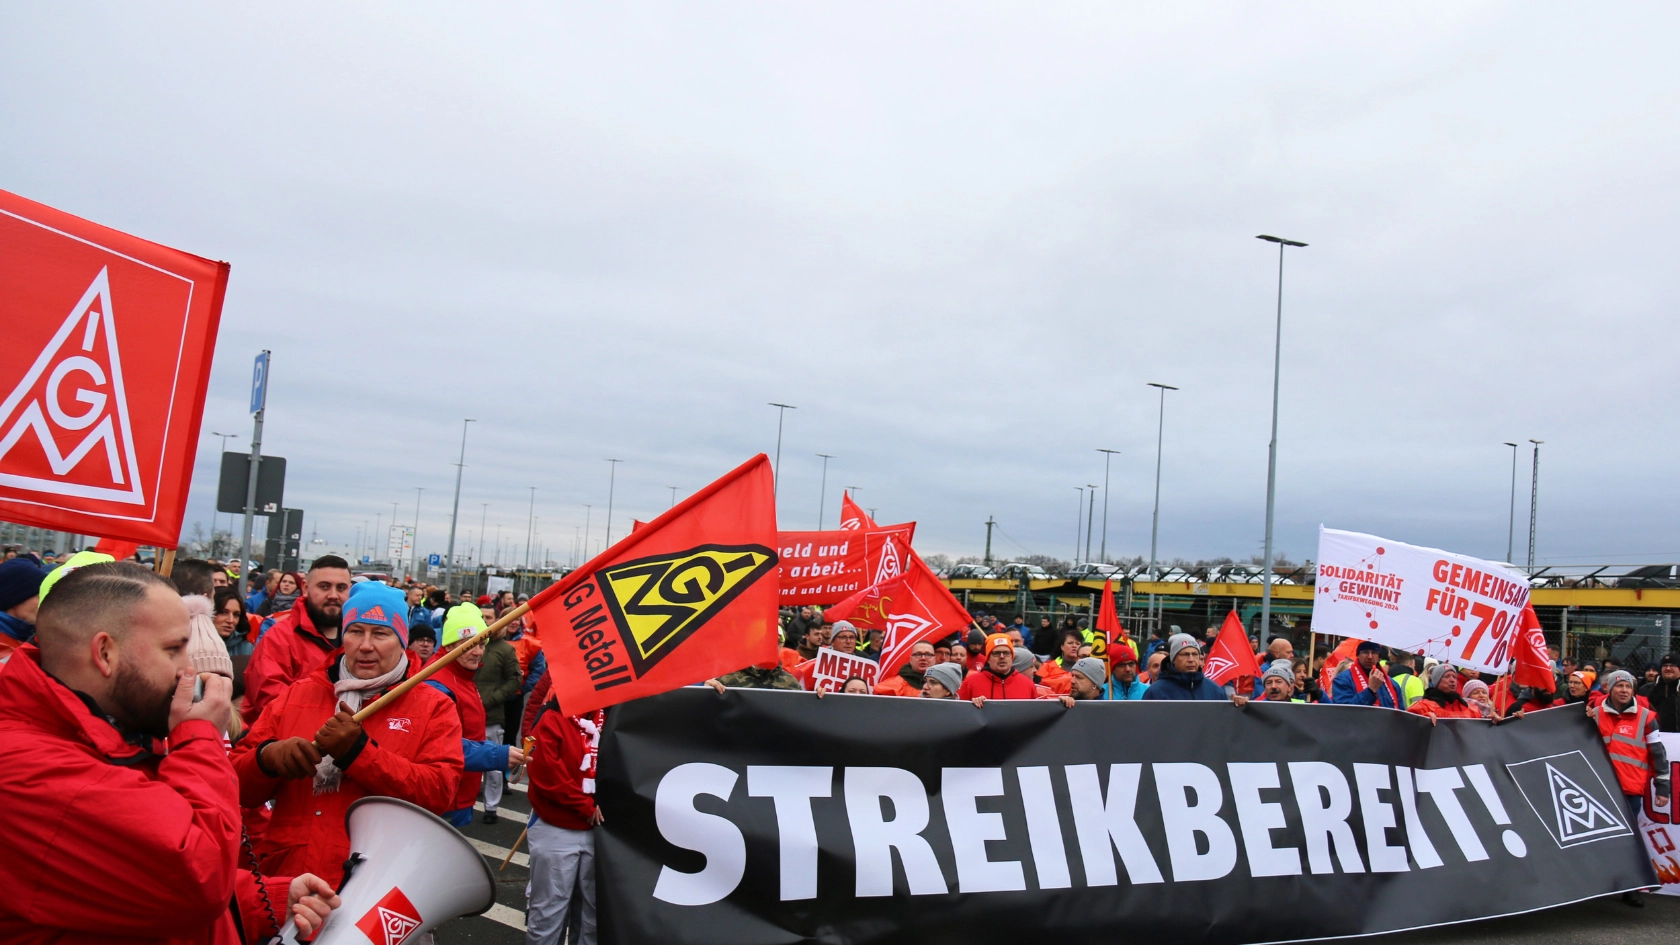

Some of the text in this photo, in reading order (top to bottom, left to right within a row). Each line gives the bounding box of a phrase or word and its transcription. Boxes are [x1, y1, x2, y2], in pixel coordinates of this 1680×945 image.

[252, 361, 264, 406] P
[430, 555, 439, 565] P
[778, 541, 849, 558] eld und
[801, 585, 823, 595] und
[826, 582, 858, 593] leute!
[1320, 564, 1404, 590] SOLIDARITÄT
[1432, 559, 1530, 609] GEMEINSAM
[1337, 593, 1399, 611] TARIFBEWEGUNG 2024
[1339, 581, 1402, 604] GEWINNT
[1425, 586, 1470, 622] FÜR
[569, 603, 633, 692] Metall
[817, 652, 877, 687] MEHR
[652, 761, 1528, 907] STREIKBEREIT!
